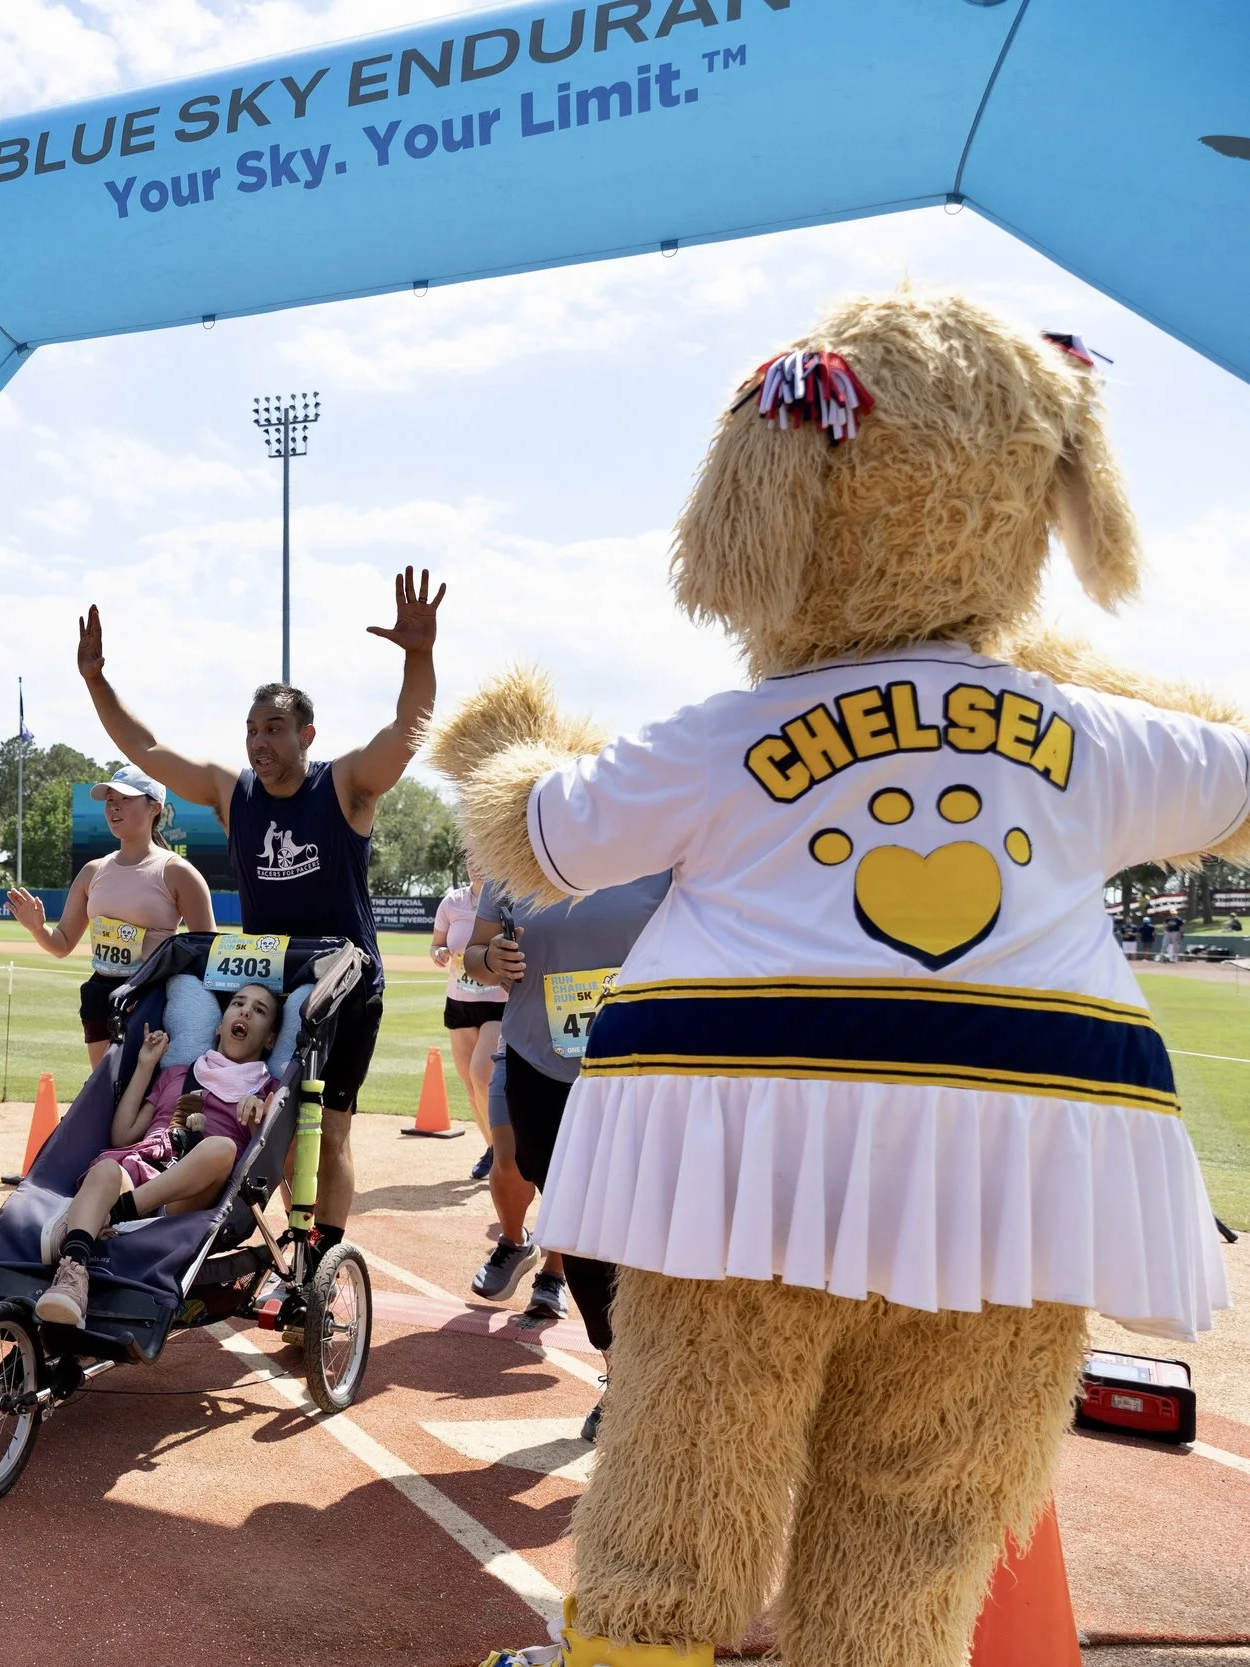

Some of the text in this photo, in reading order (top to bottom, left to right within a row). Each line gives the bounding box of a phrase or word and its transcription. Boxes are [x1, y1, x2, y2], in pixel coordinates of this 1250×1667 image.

[174, 67, 331, 142] SKY
[104, 176, 221, 218] Your
[236, 143, 347, 193] Sky.
[362, 108, 500, 166] Your
[744, 681, 1075, 803] CHELSEA
[296, 861, 320, 873] PACERS
[95, 943, 131, 965] 4789
[217, 957, 271, 978] 4303
[551, 975, 573, 985] RUN
[552, 981, 598, 994] CHARLIE
[554, 991, 592, 1003] RUN 5K
